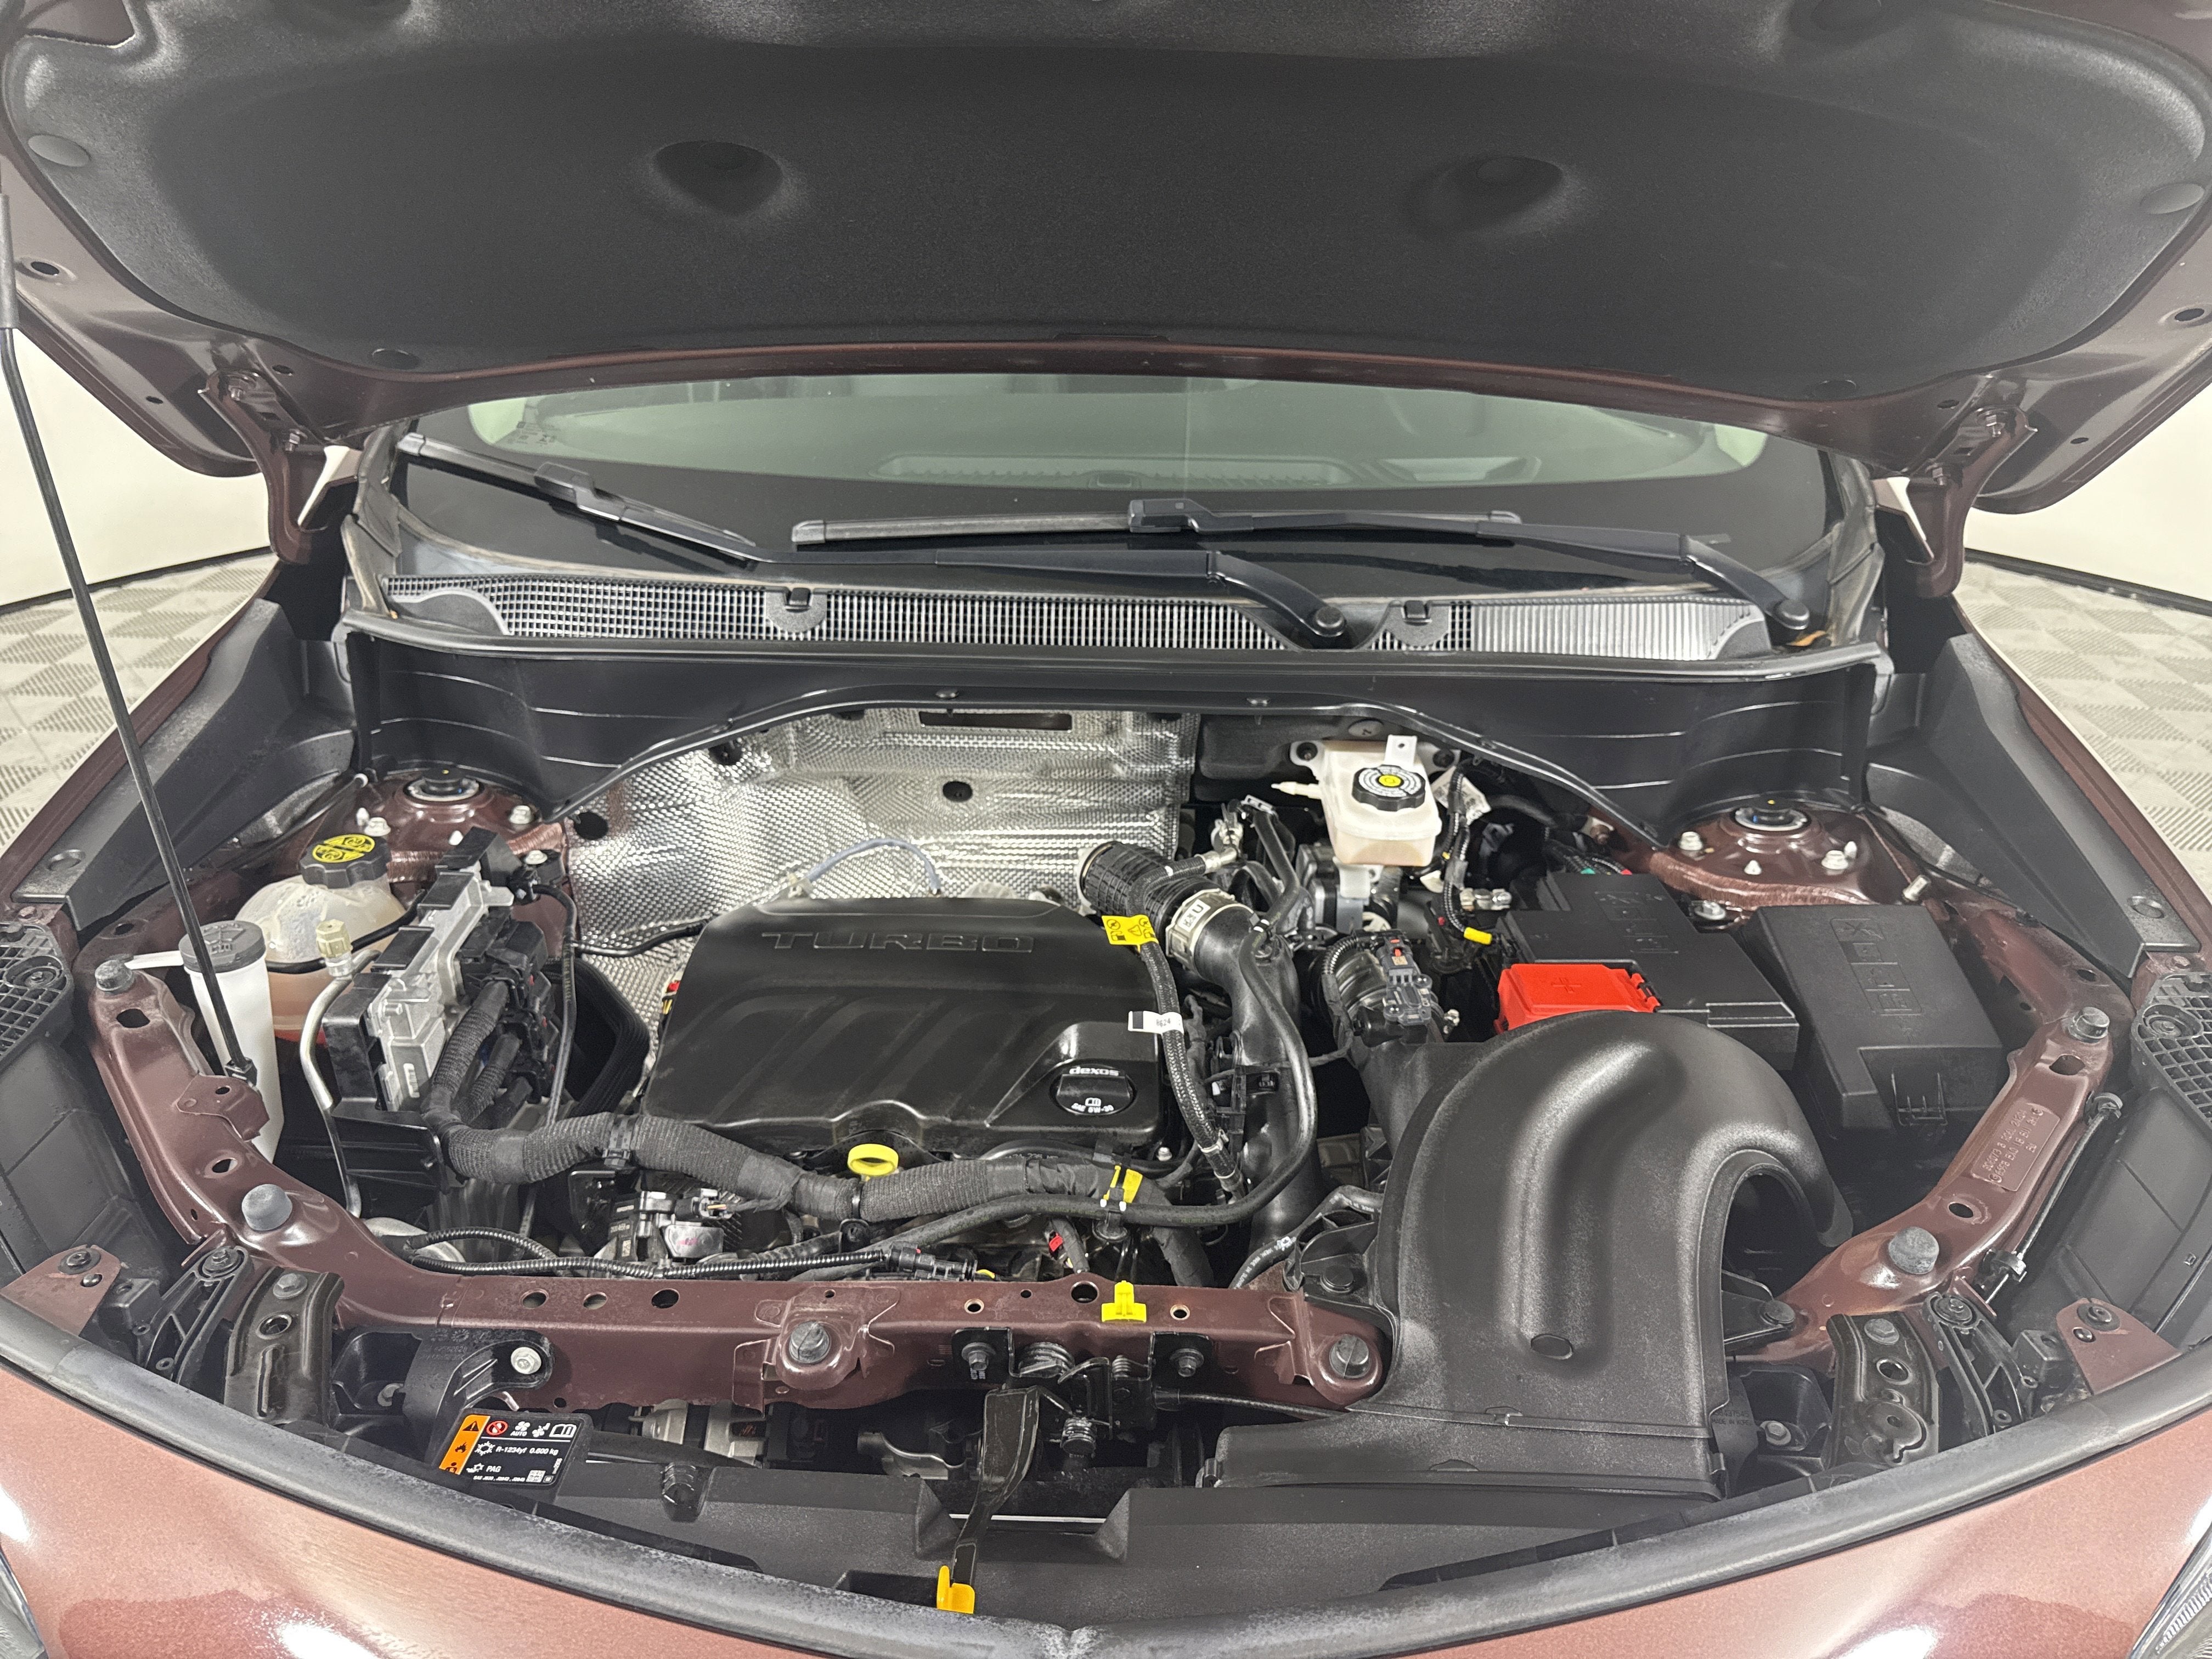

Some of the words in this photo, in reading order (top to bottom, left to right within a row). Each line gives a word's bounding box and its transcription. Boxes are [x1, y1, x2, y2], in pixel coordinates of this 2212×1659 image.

[761, 932, 1034, 953] TURBO
[1069, 1066, 1119, 1076] dexos
[495, 1446, 528, 1454] R-1234yf
